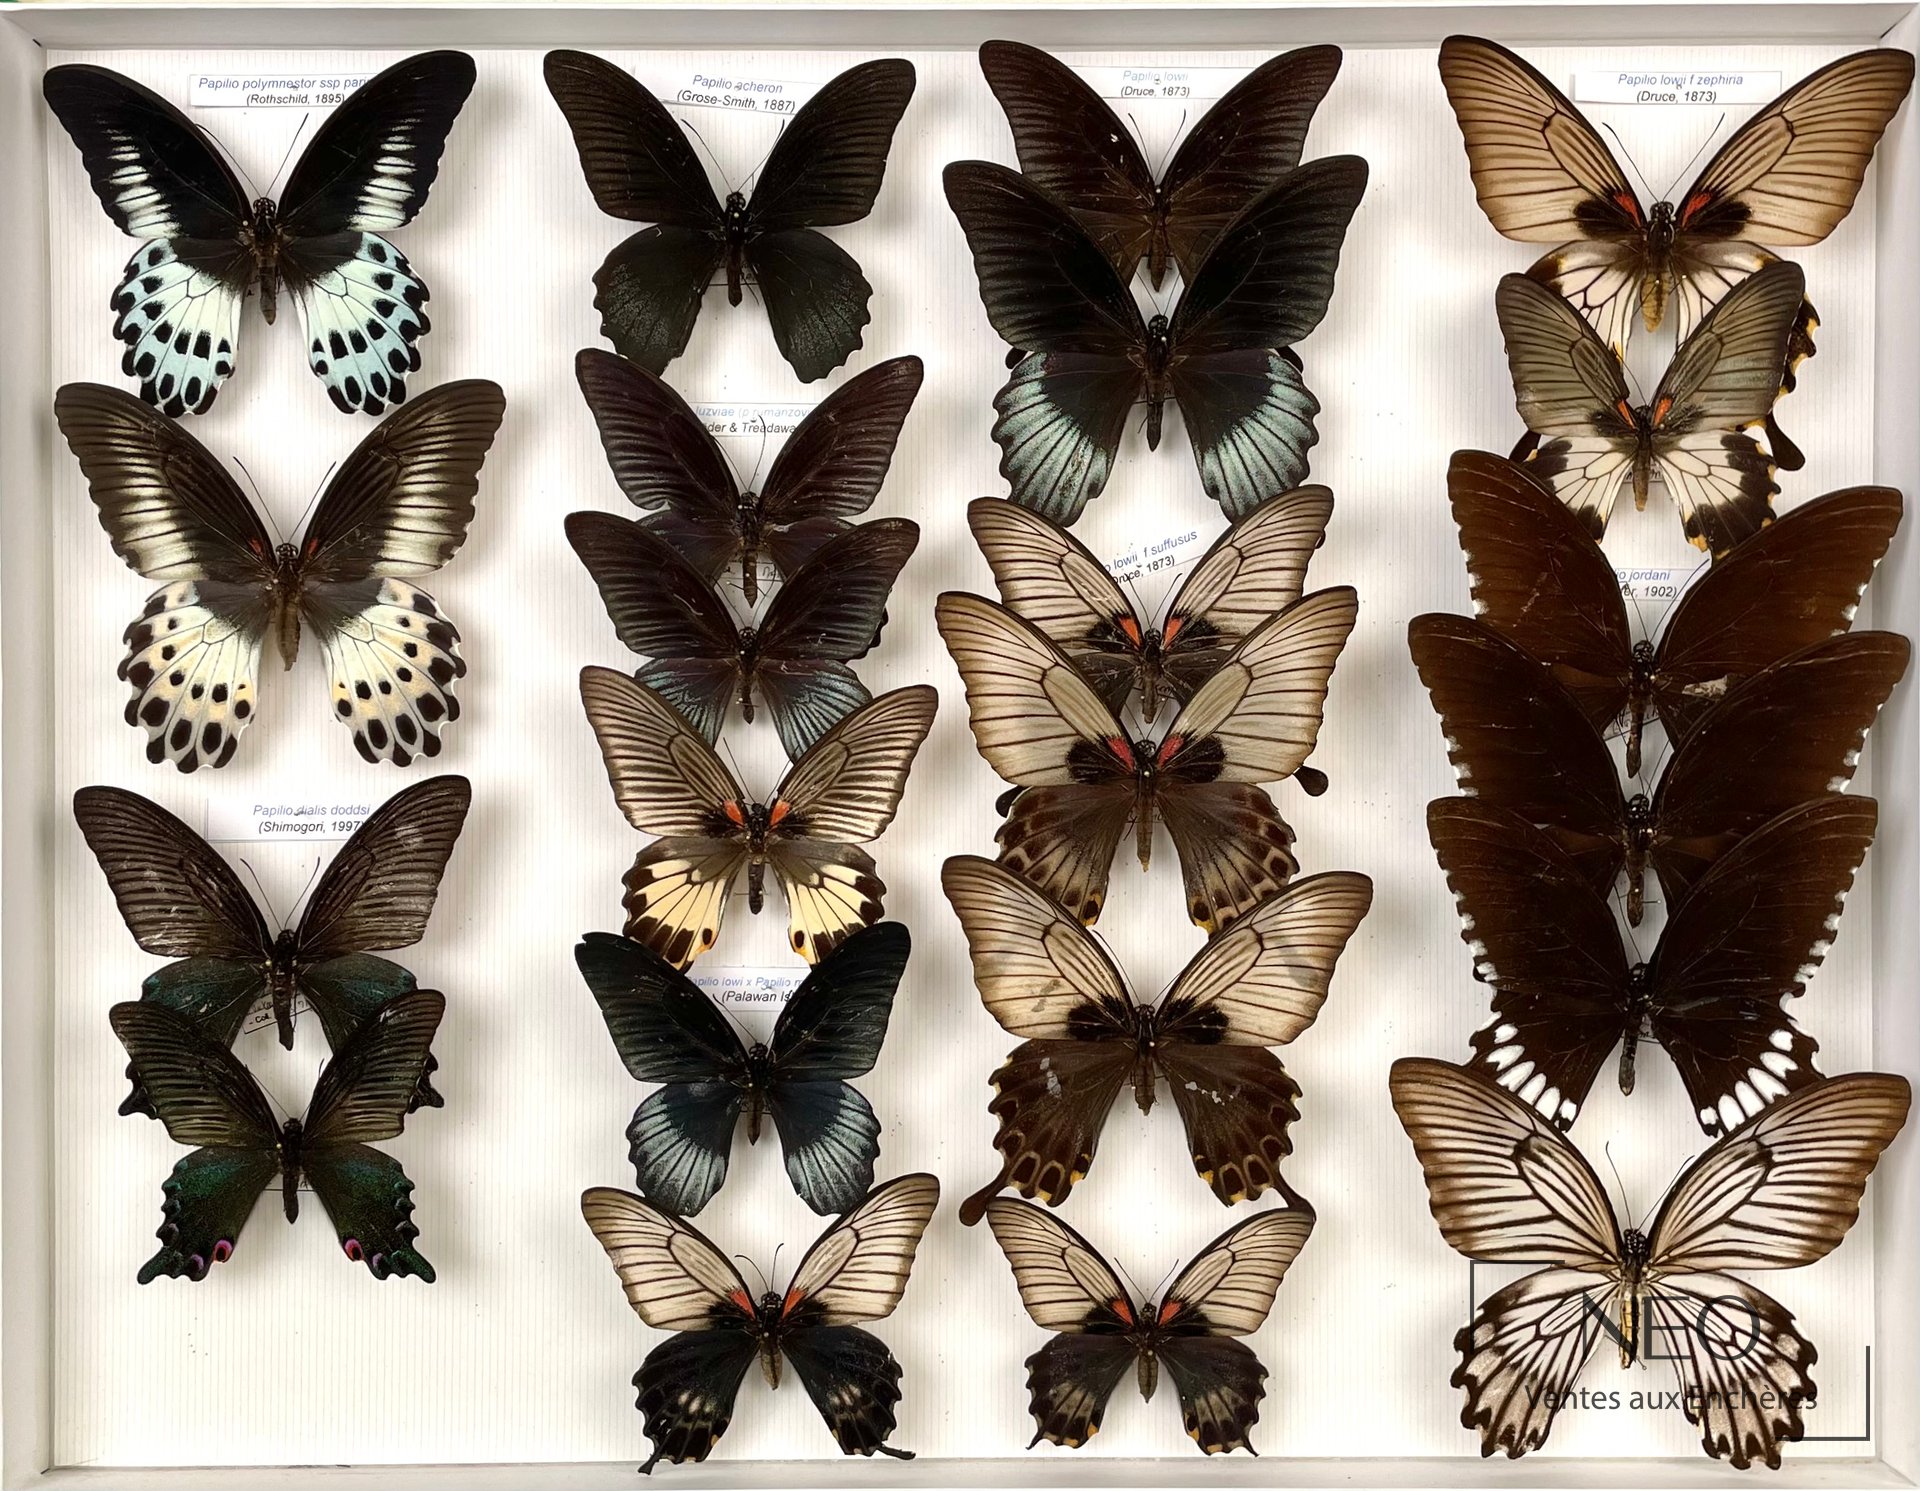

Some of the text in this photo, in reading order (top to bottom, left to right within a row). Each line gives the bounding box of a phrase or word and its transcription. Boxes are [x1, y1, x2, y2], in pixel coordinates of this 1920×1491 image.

[1123, 70, 1160, 83] Papilio
[1618, 74, 1657, 87] Papilio
[1689, 74, 1695, 85] f
[1697, 74, 1743, 87] zephiria
[199, 78, 239, 91] Papilio
[242, 78, 317, 91] polymnestor
[319, 79, 340, 90] ssp
[692, 75, 783, 93] Papilio acheron
[1120, 86, 1190, 98] (Druce, 1873)
[1636, 90, 1717, 104] (Druce, 1873)
[246, 93, 345, 106] (Rothschild, 1895)
[677, 89, 796, 114] (Grose-Smith, 1887)
[729, 422, 738, 433] &
[1113, 552, 1138, 570] lowii
[1151, 531, 1198, 556] suffusus
[1146, 554, 1175, 573] 1873)
[1629, 570, 1671, 582] jordani
[1645, 586, 1677, 599] 1902)
[253, 804, 370, 817] Papilio dialis doddsi
[259, 821, 326, 834] (Shimogori,
[755, 977, 791, 988] Papilio
[722, 990, 776, 1003] (Palawan
